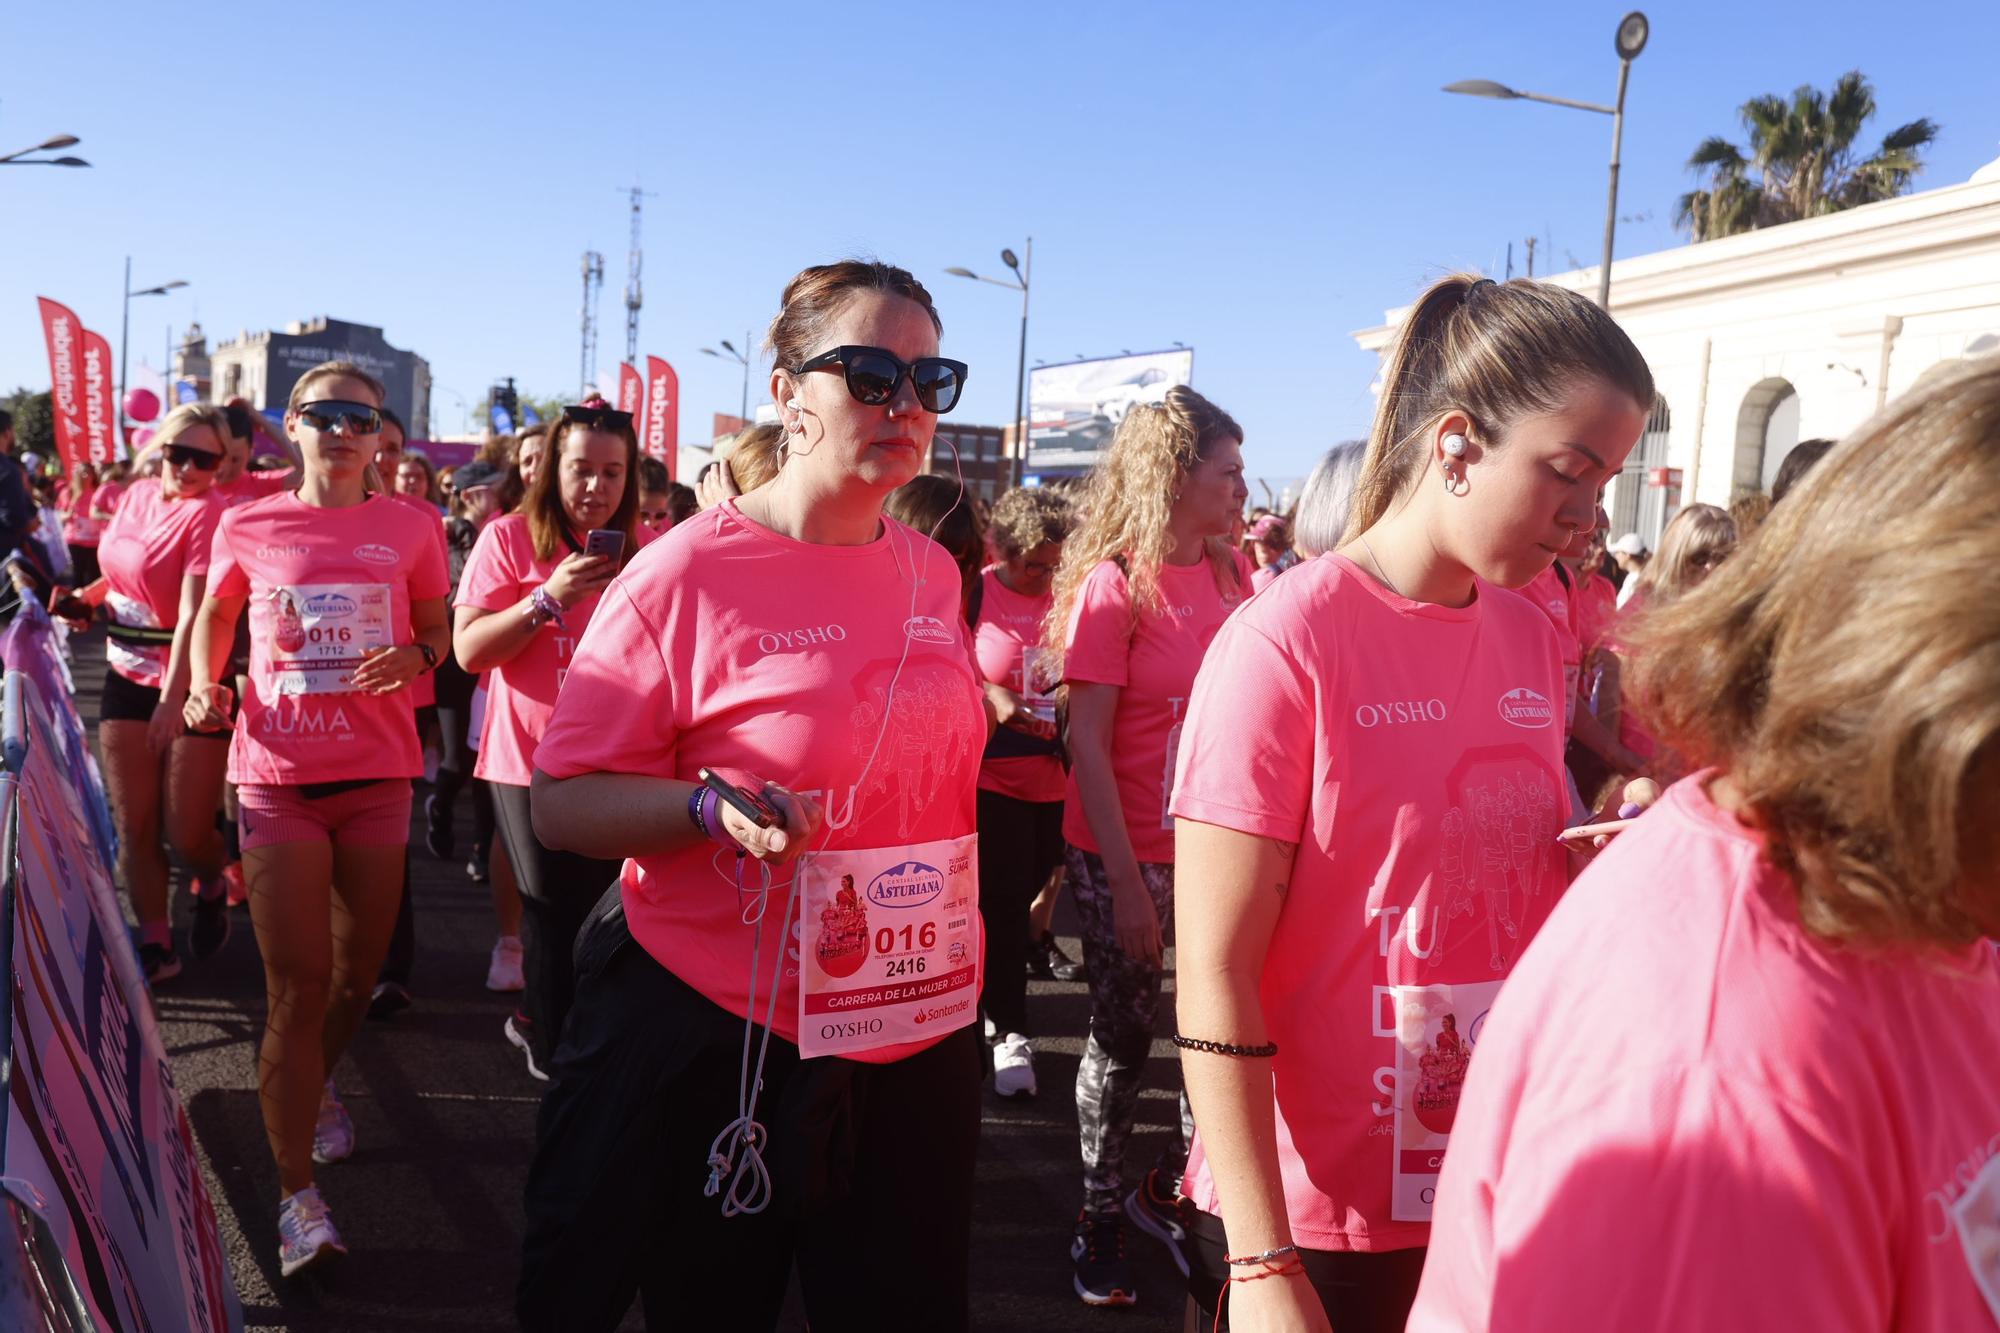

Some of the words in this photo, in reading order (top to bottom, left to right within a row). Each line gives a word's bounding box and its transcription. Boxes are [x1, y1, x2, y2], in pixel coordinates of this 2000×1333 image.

[257, 544, 309, 559] OYSHO
[306, 601, 353, 612] ASTURIANA
[309, 627, 351, 643] 016
[758, 624, 846, 653] OYSHO
[318, 646, 344, 655] 1712
[263, 707, 350, 733] SUMA
[1356, 698, 1447, 728] OYSHO
[1504, 703, 1550, 719] ASTURIANA
[874, 880, 940, 900] ASTURIANA
[874, 921, 937, 954] 016
[1370, 905, 1439, 959] TU
[886, 957, 926, 977] 2416
[828, 991, 882, 1007] CARRERA
[884, 989, 900, 1000] DE
[902, 985, 916, 997] LA
[918, 979, 948, 993] MUJER
[950, 973, 968, 986] 2023
[927, 999, 970, 1021] Santander
[821, 1018, 883, 1040] OYSHO
